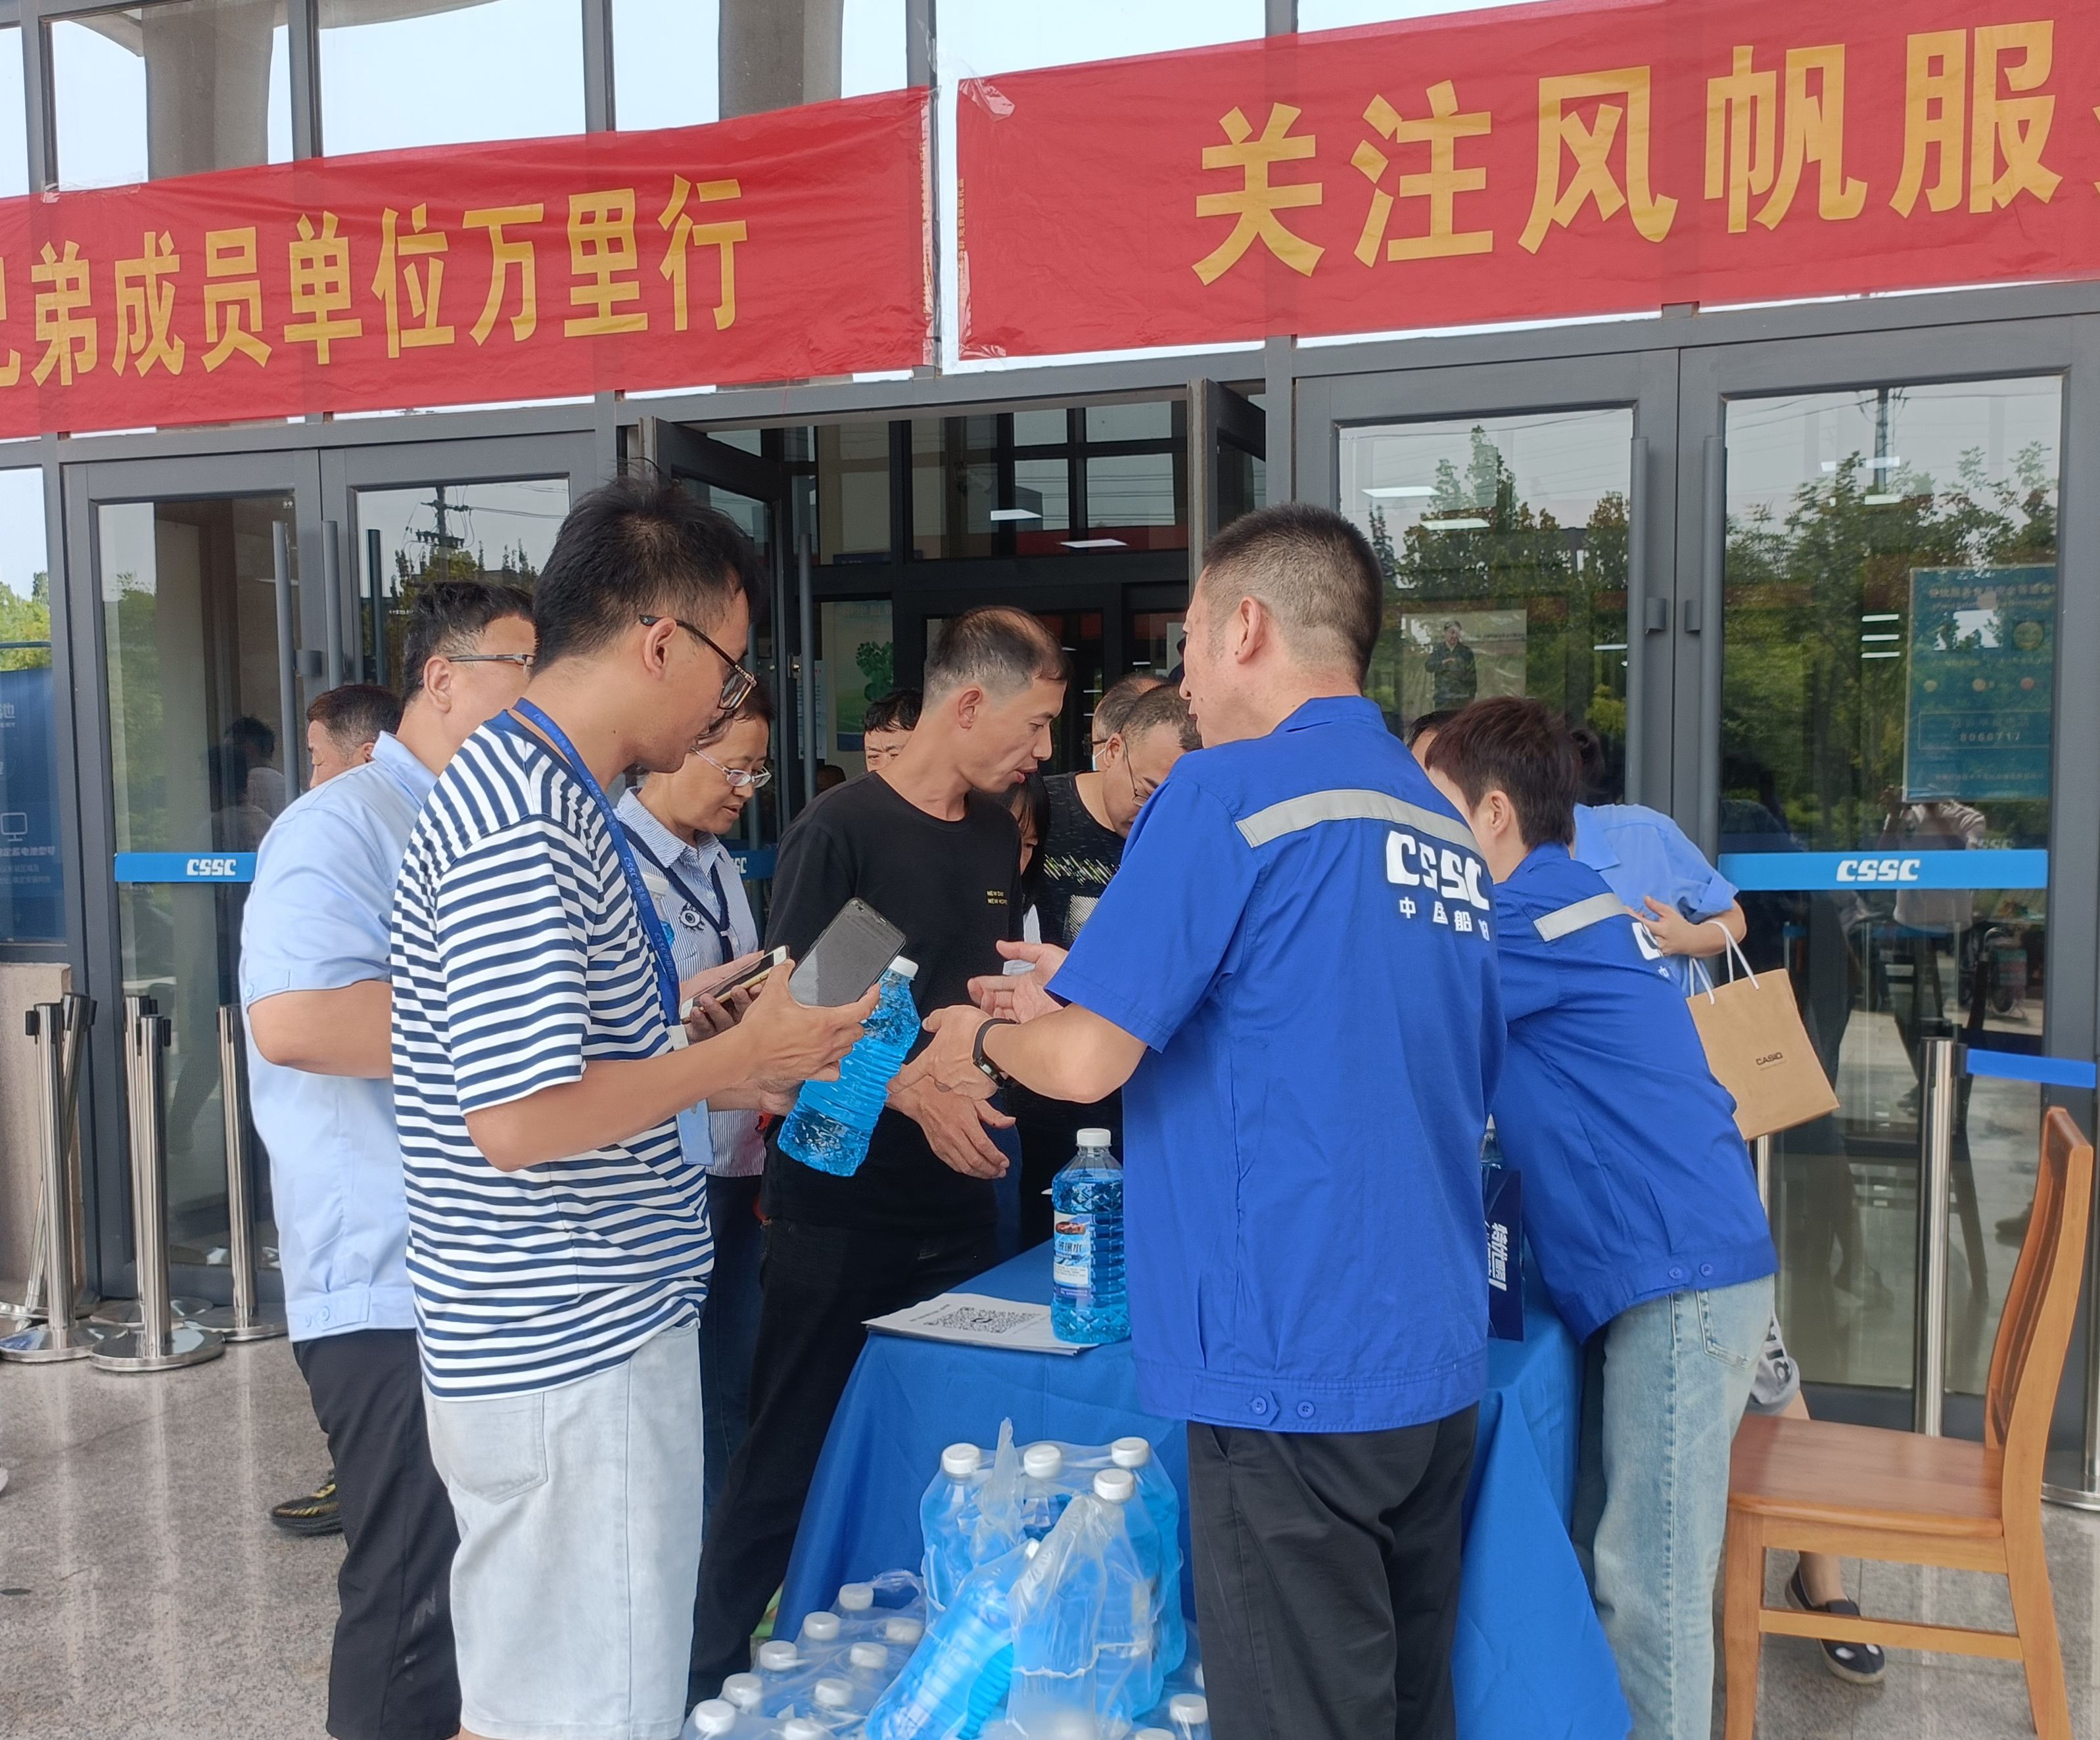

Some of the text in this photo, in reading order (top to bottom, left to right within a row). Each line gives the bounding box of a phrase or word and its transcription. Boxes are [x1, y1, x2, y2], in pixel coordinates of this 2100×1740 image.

[1192, 19, 2100, 285] 关注风帆服
[187, 858, 237, 877] CSSC
[624, 856, 638, 878] CSSC
[1386, 830, 1490, 910] CSSC
[1836, 858, 1921, 882] CSSC
[1756, 1052, 1783, 1066] CASIO
